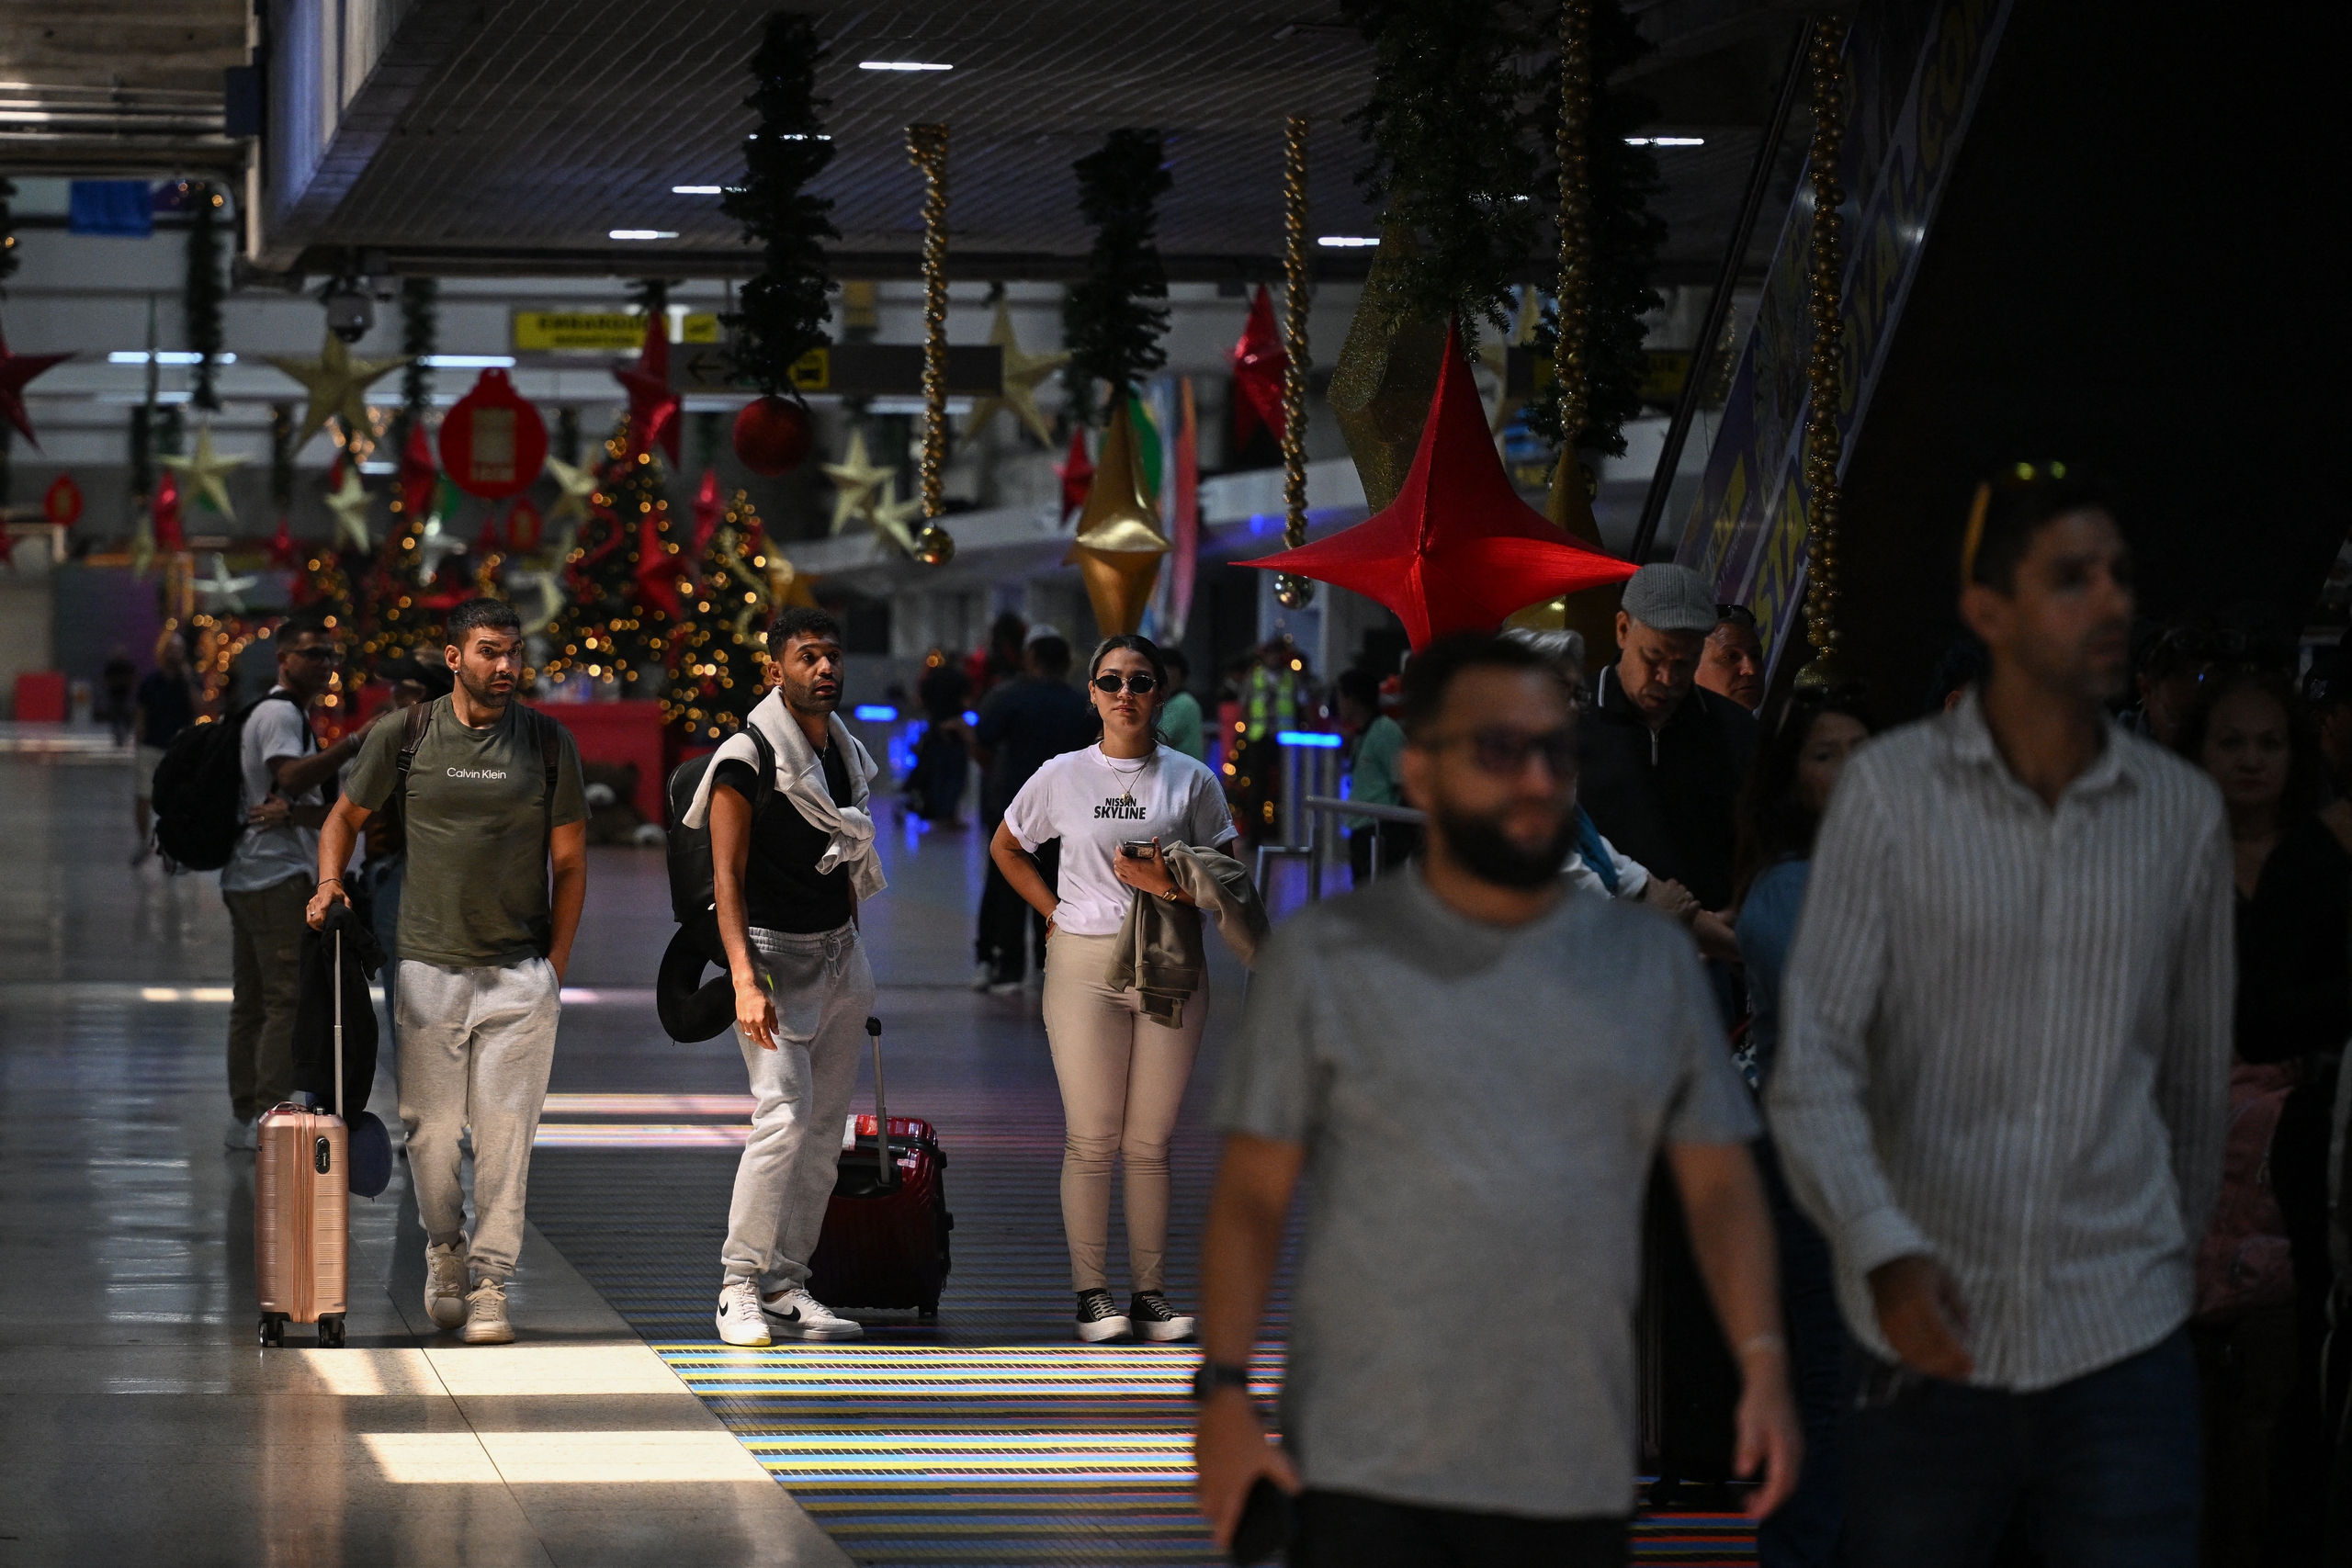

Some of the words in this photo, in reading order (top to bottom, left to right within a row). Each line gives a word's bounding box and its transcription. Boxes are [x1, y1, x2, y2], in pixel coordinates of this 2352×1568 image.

[447, 767, 481, 779] Calvin
[481, 769, 507, 780] Klein
[1105, 797, 1137, 807] NISSAN
[1093, 806, 1147, 819] SKYLINE
